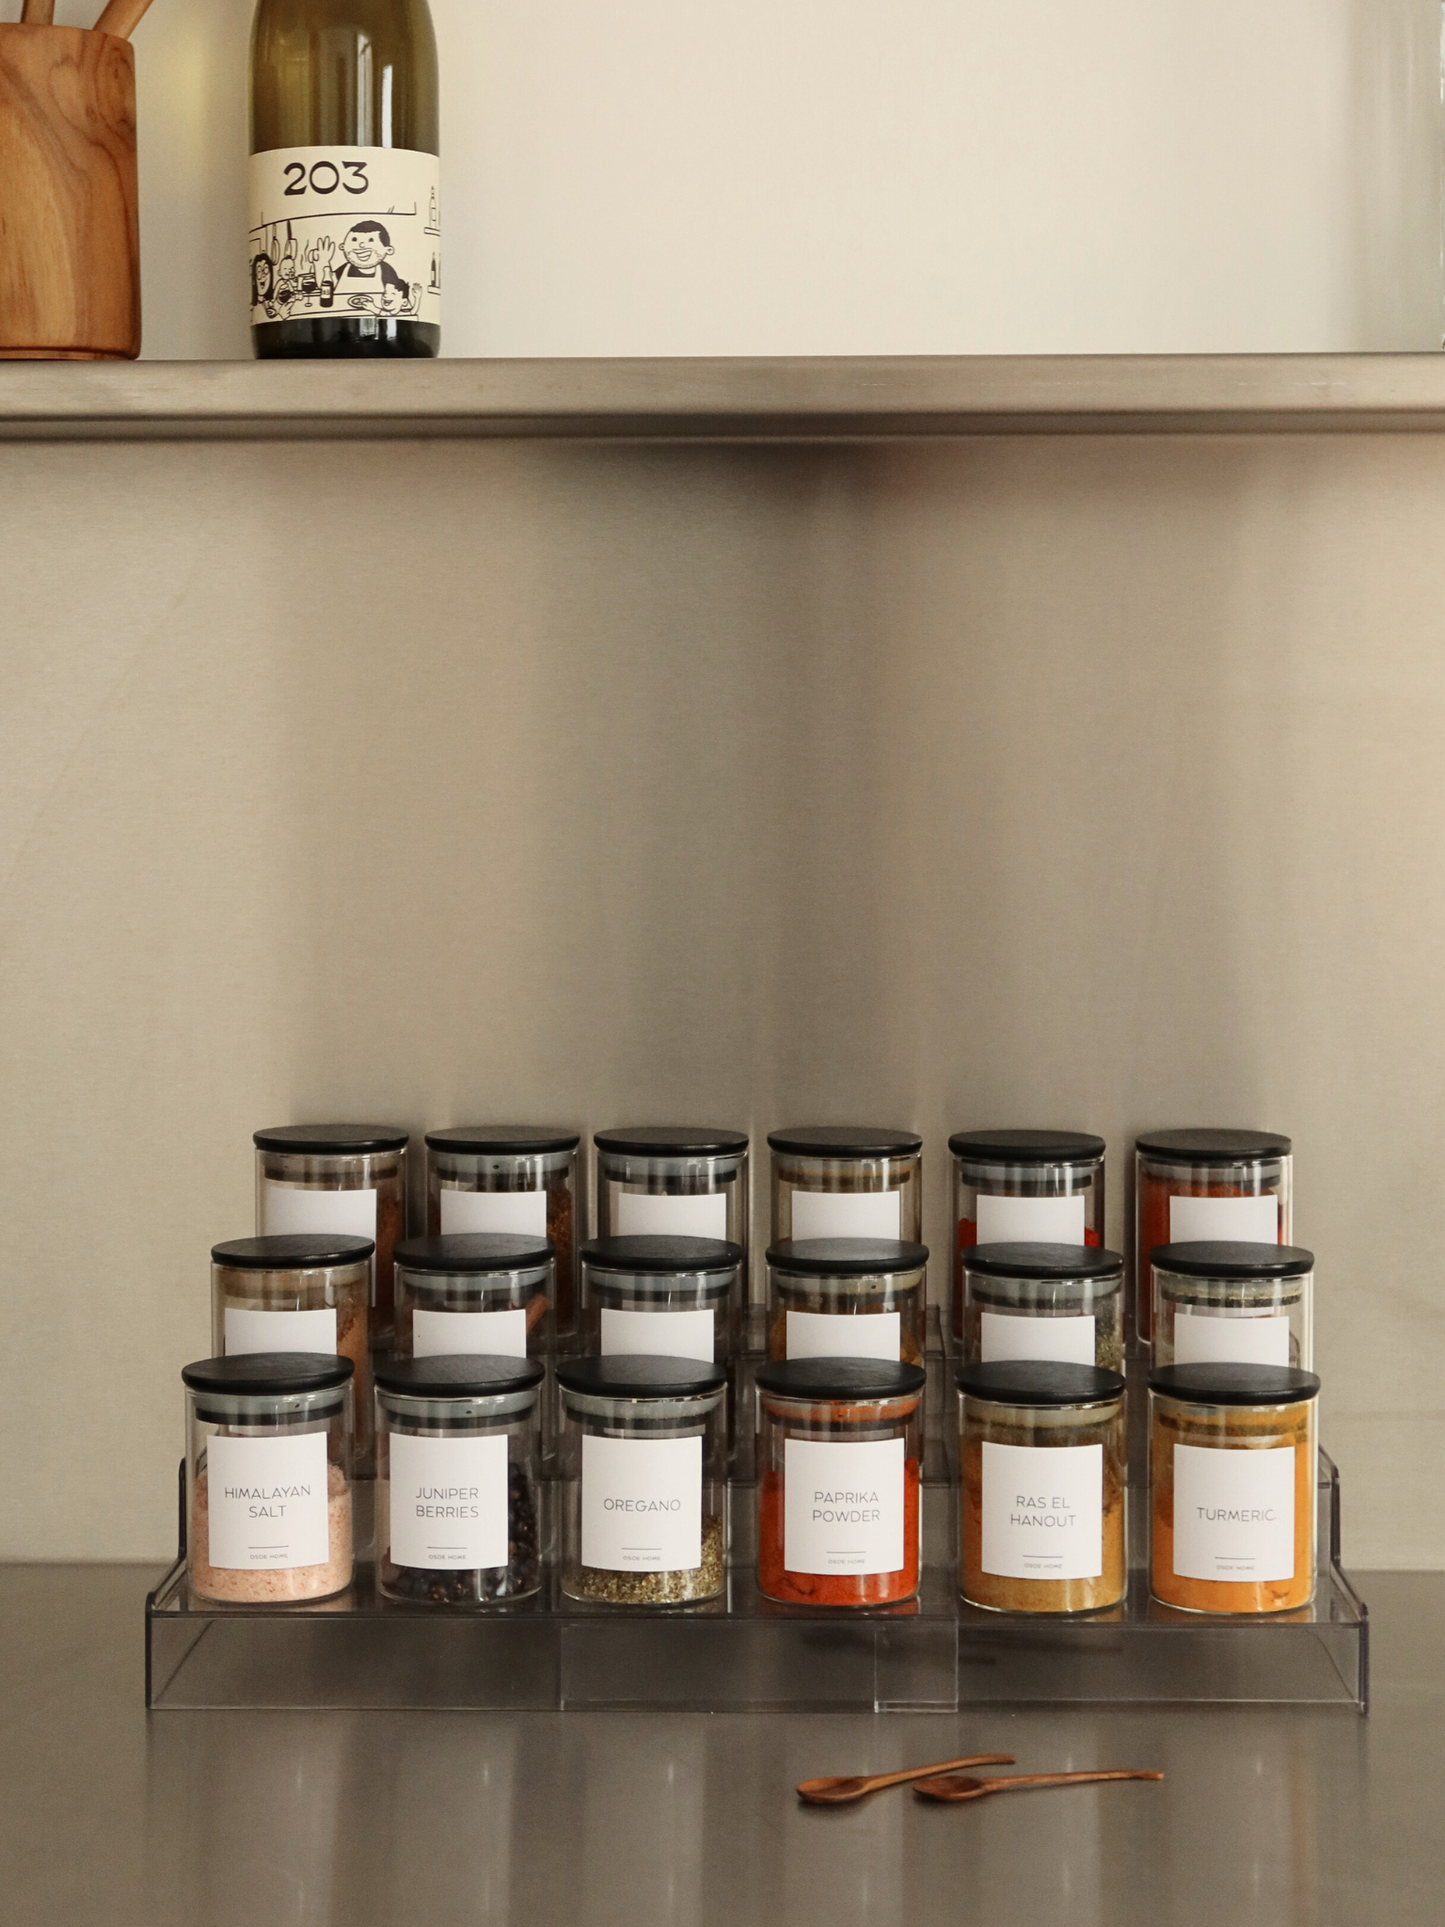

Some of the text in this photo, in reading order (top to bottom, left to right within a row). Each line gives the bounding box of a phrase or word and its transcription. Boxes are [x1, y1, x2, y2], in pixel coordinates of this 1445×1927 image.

[283, 160, 369, 196] 203
[224, 1485, 311, 1500] HIMALAYAN
[415, 1487, 479, 1500] JUNIPER
[814, 1491, 880, 1504] PAPRIKA
[603, 1498, 682, 1512] OREGANO
[1016, 1495, 1071, 1509] RAS EL
[248, 1505, 287, 1519] SALT
[415, 1505, 479, 1518] BERRIES
[812, 1510, 881, 1523] POWDER
[1196, 1507, 1278, 1522] TURMERIC
[1010, 1514, 1077, 1528] HANOUT
